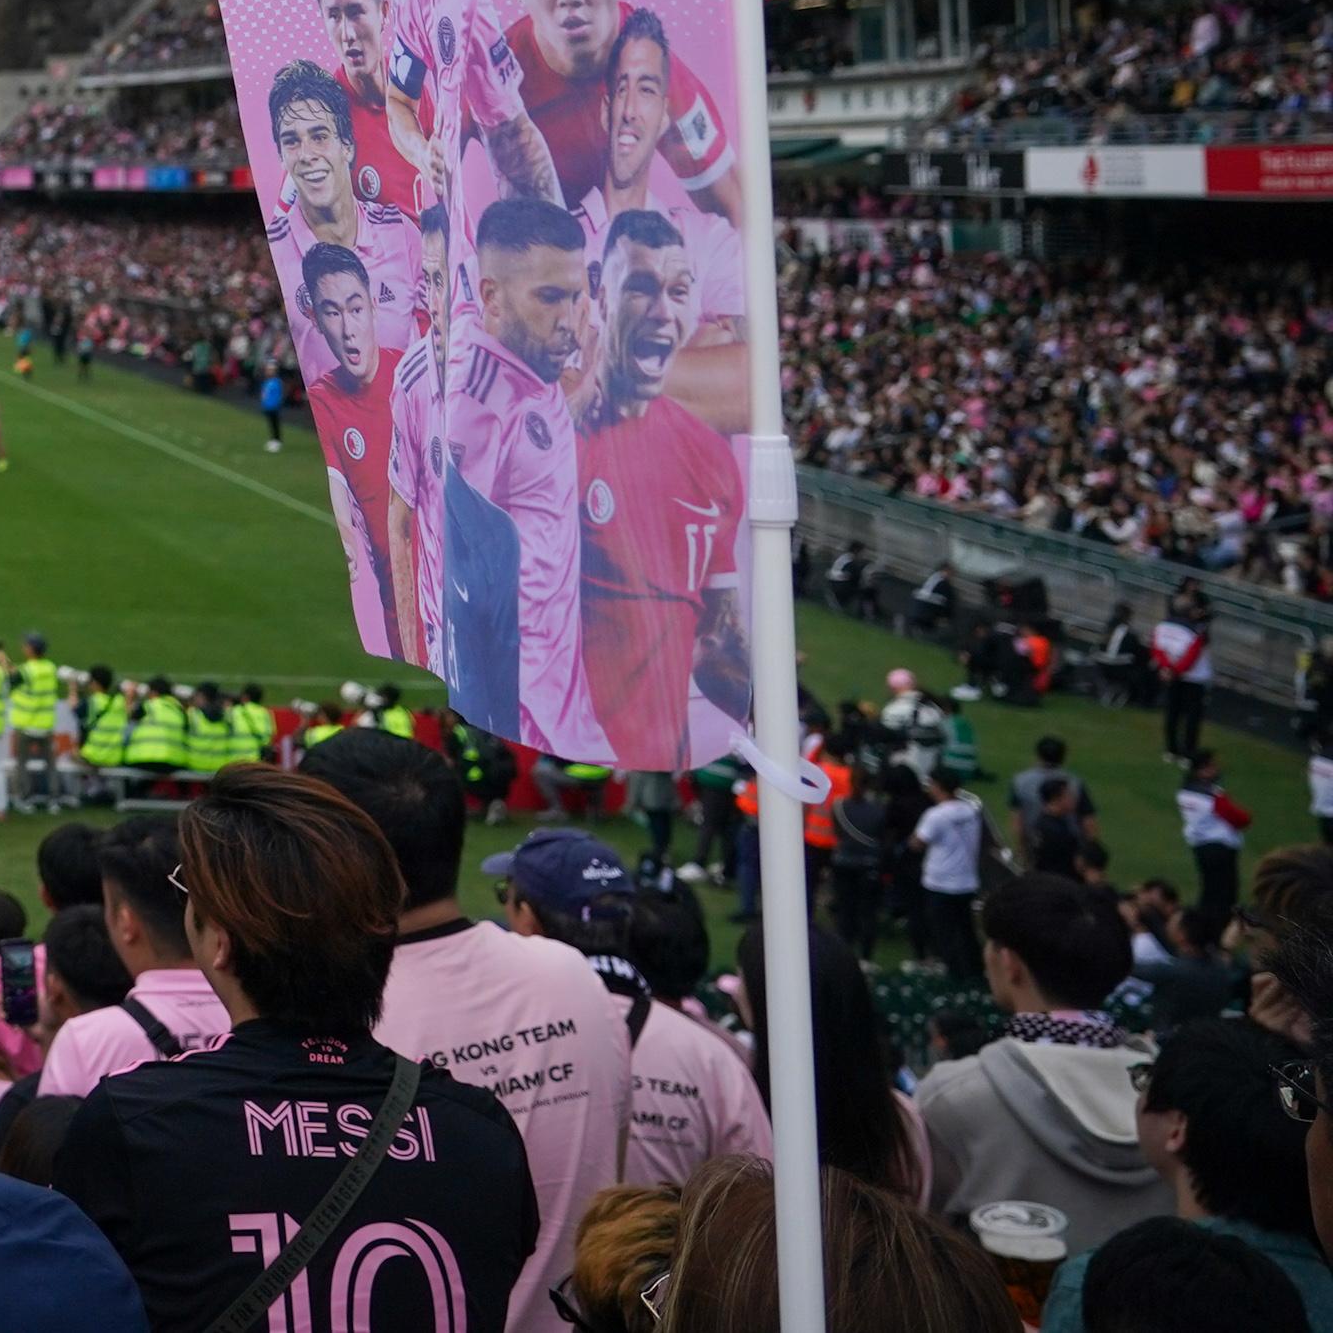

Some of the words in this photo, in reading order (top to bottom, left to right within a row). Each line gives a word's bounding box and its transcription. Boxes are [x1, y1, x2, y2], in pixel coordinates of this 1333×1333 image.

[451, 1034, 514, 1065] KONG
[517, 1019, 577, 1047] TEAM
[309, 1053, 345, 1065] DREAM
[548, 1063, 574, 1082] CF
[648, 1077, 700, 1099] TEAM
[228, 1212, 469, 1333] 10
